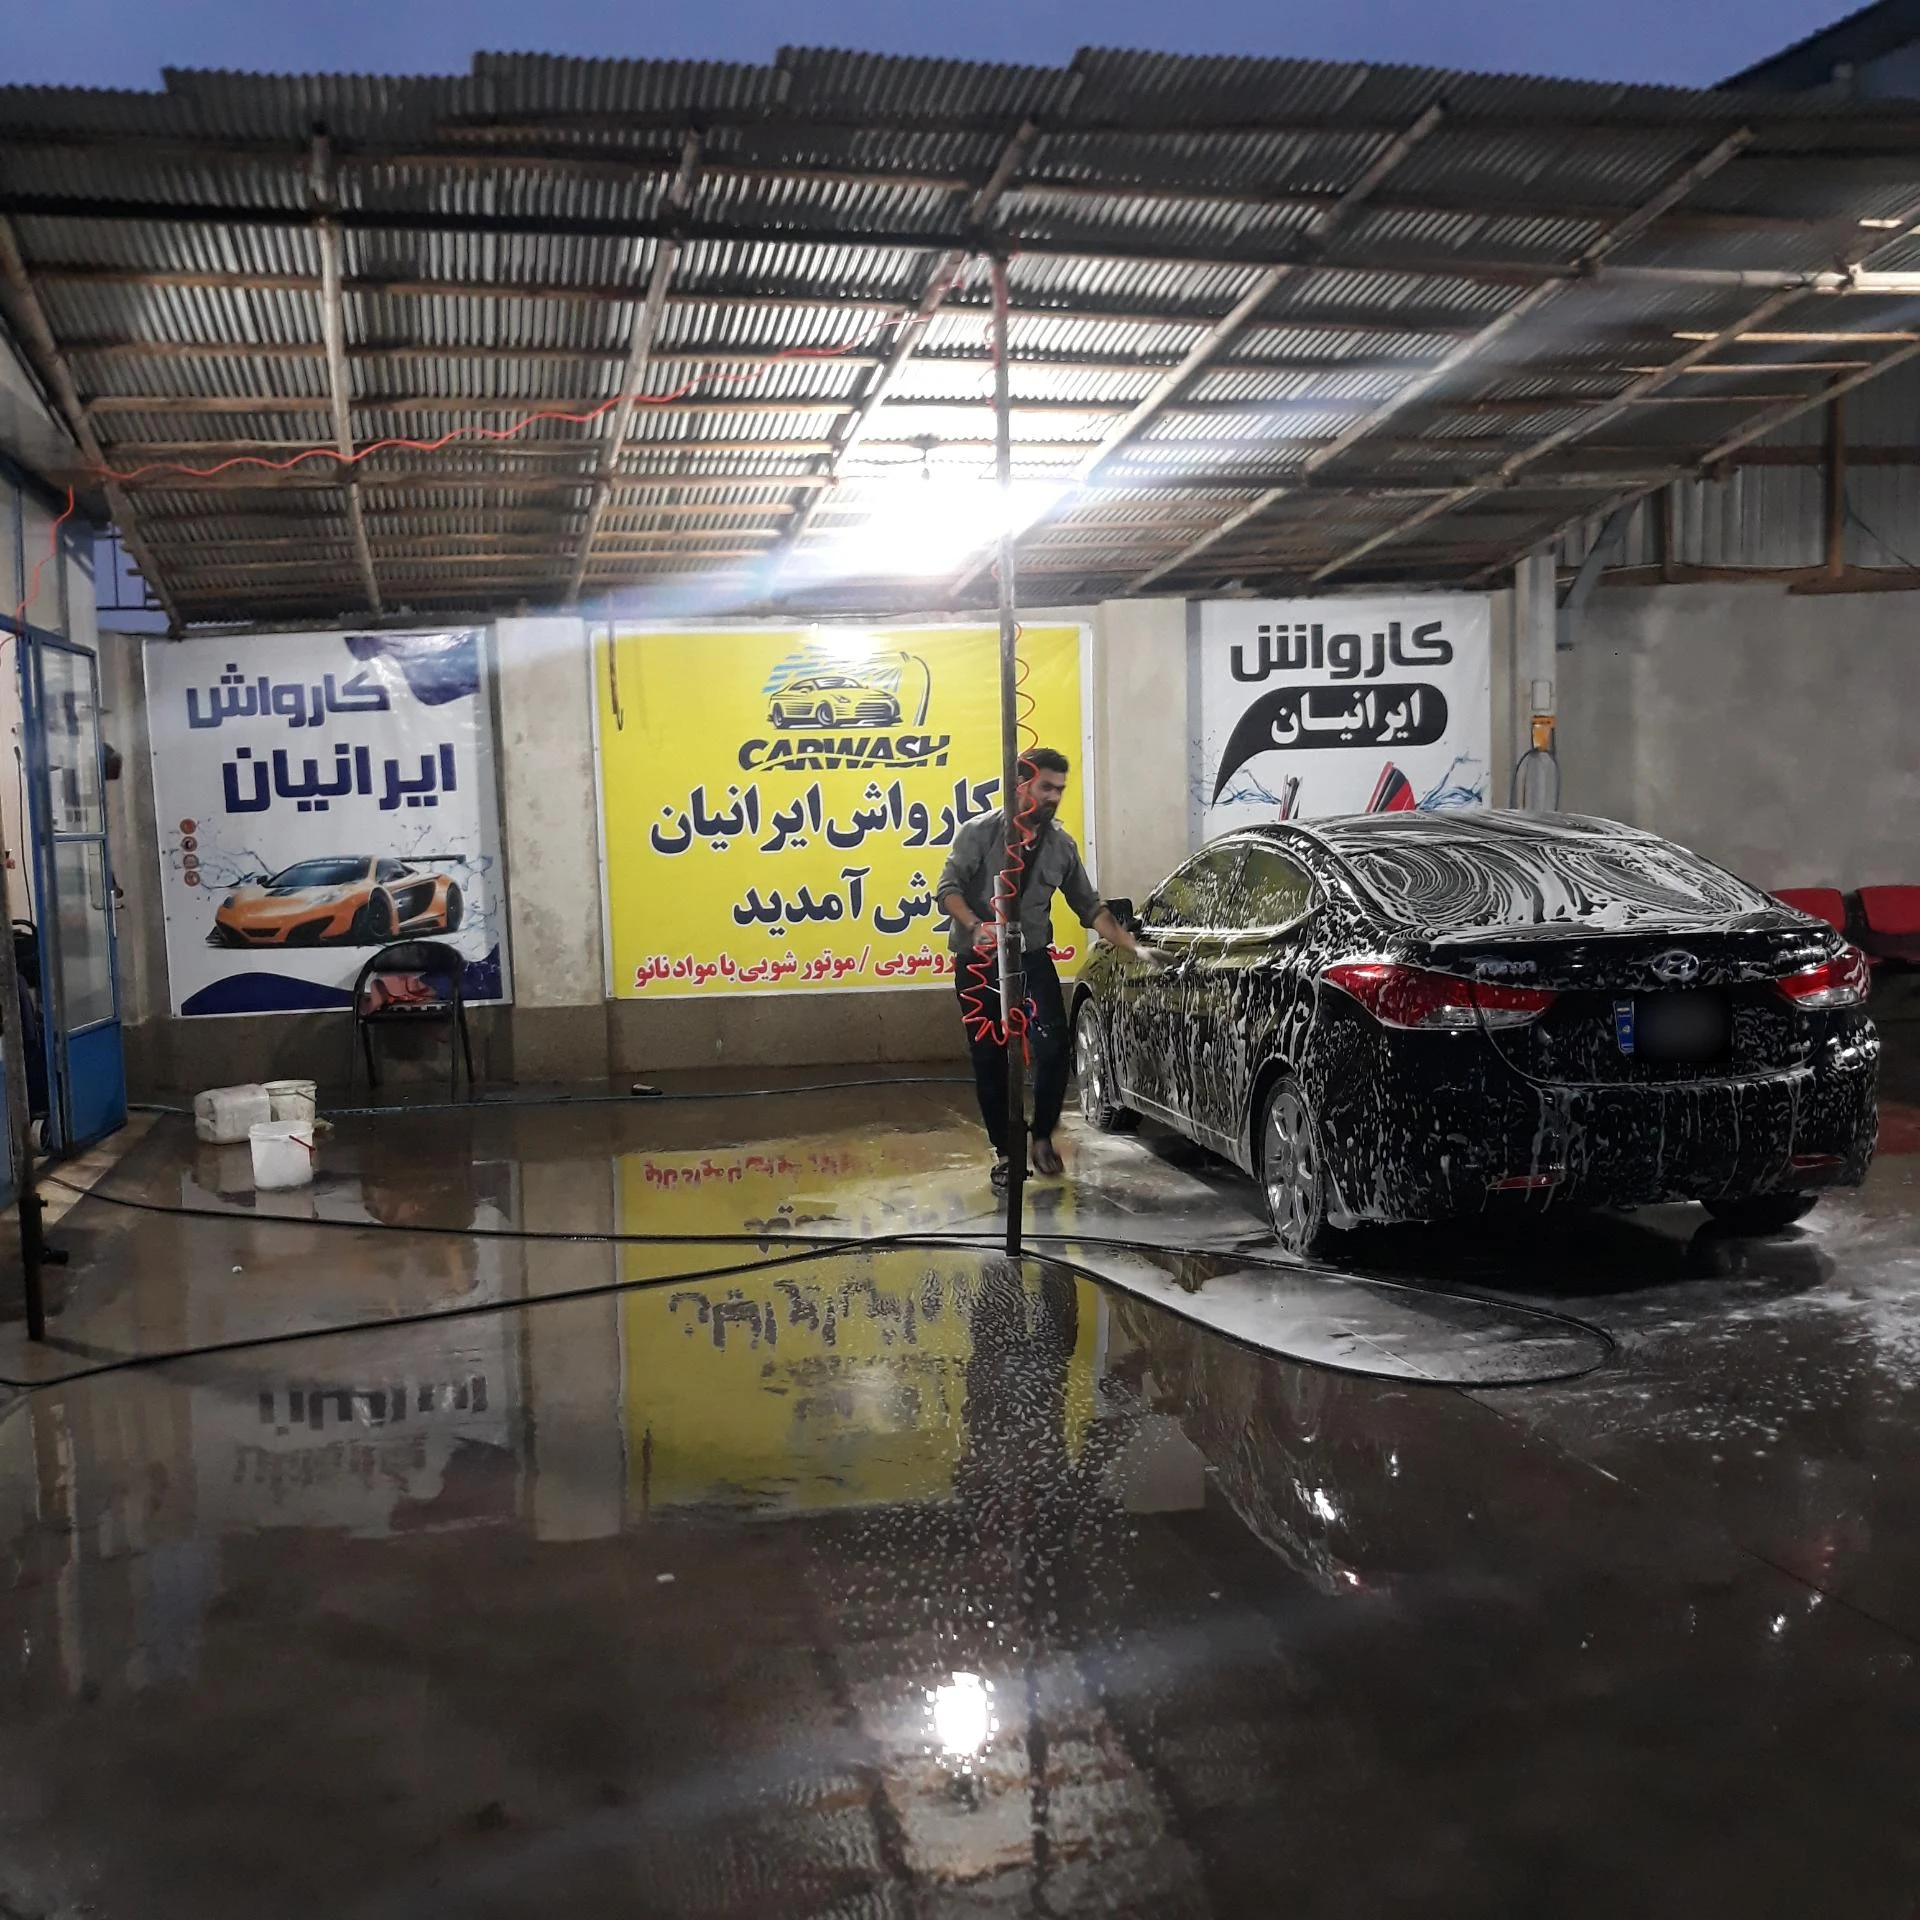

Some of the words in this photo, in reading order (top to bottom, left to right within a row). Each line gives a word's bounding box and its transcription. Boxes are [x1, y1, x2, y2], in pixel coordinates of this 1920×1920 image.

[1230, 621, 1454, 682] کارواش
[186, 663, 391, 729] کارواش
[1271, 689, 1421, 744] ایرانیان
[222, 743, 458, 813] ایرانیان
[738, 735, 951, 771] CARWASH
[651, 782, 821, 854] ایرانیان
[733, 867, 870, 935] آمدید
[635, 956, 670, 988] نانو
[673, 955, 717, 985] مواد
[800, 950, 856, 980] موتور
